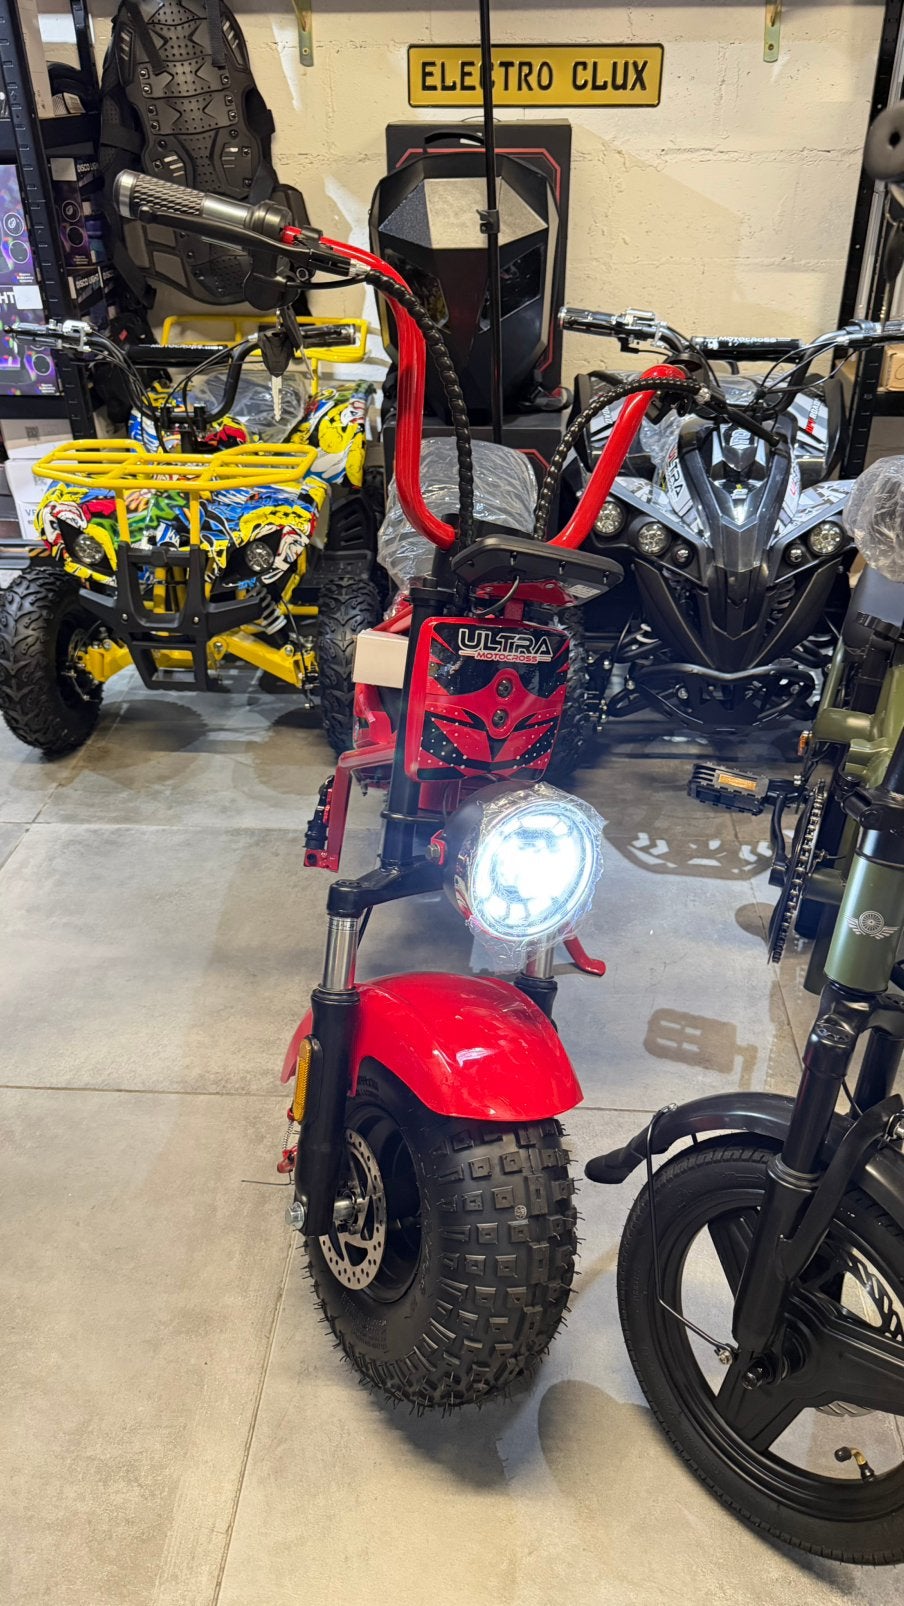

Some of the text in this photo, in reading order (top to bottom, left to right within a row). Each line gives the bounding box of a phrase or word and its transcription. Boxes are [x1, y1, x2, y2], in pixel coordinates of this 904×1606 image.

[572, 60, 648, 91] CLUX
[458, 629, 553, 656] ULTRA
[476, 652, 538, 662] MOTOCROSS
